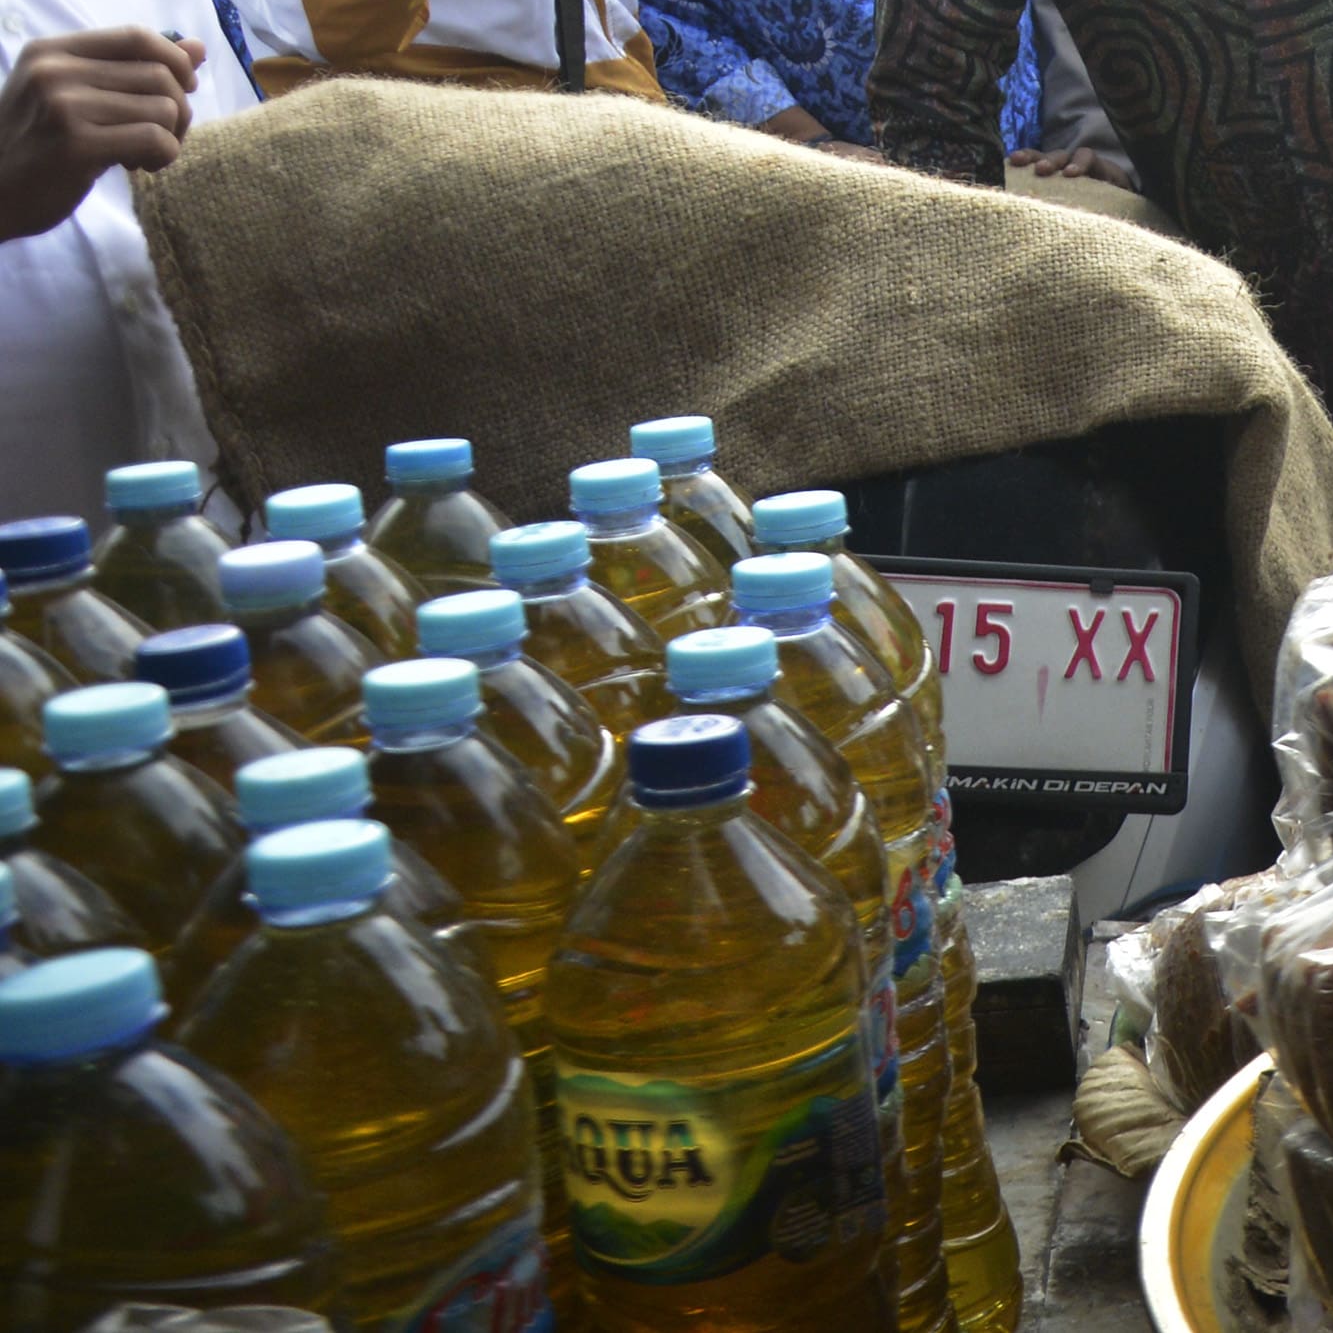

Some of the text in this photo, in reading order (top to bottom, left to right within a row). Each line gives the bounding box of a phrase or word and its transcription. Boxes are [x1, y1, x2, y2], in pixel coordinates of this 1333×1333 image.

[1063, 607, 1160, 683] XX
[1074, 779, 1167, 796] DEPAN
[567, 1113, 715, 1203] QUA
